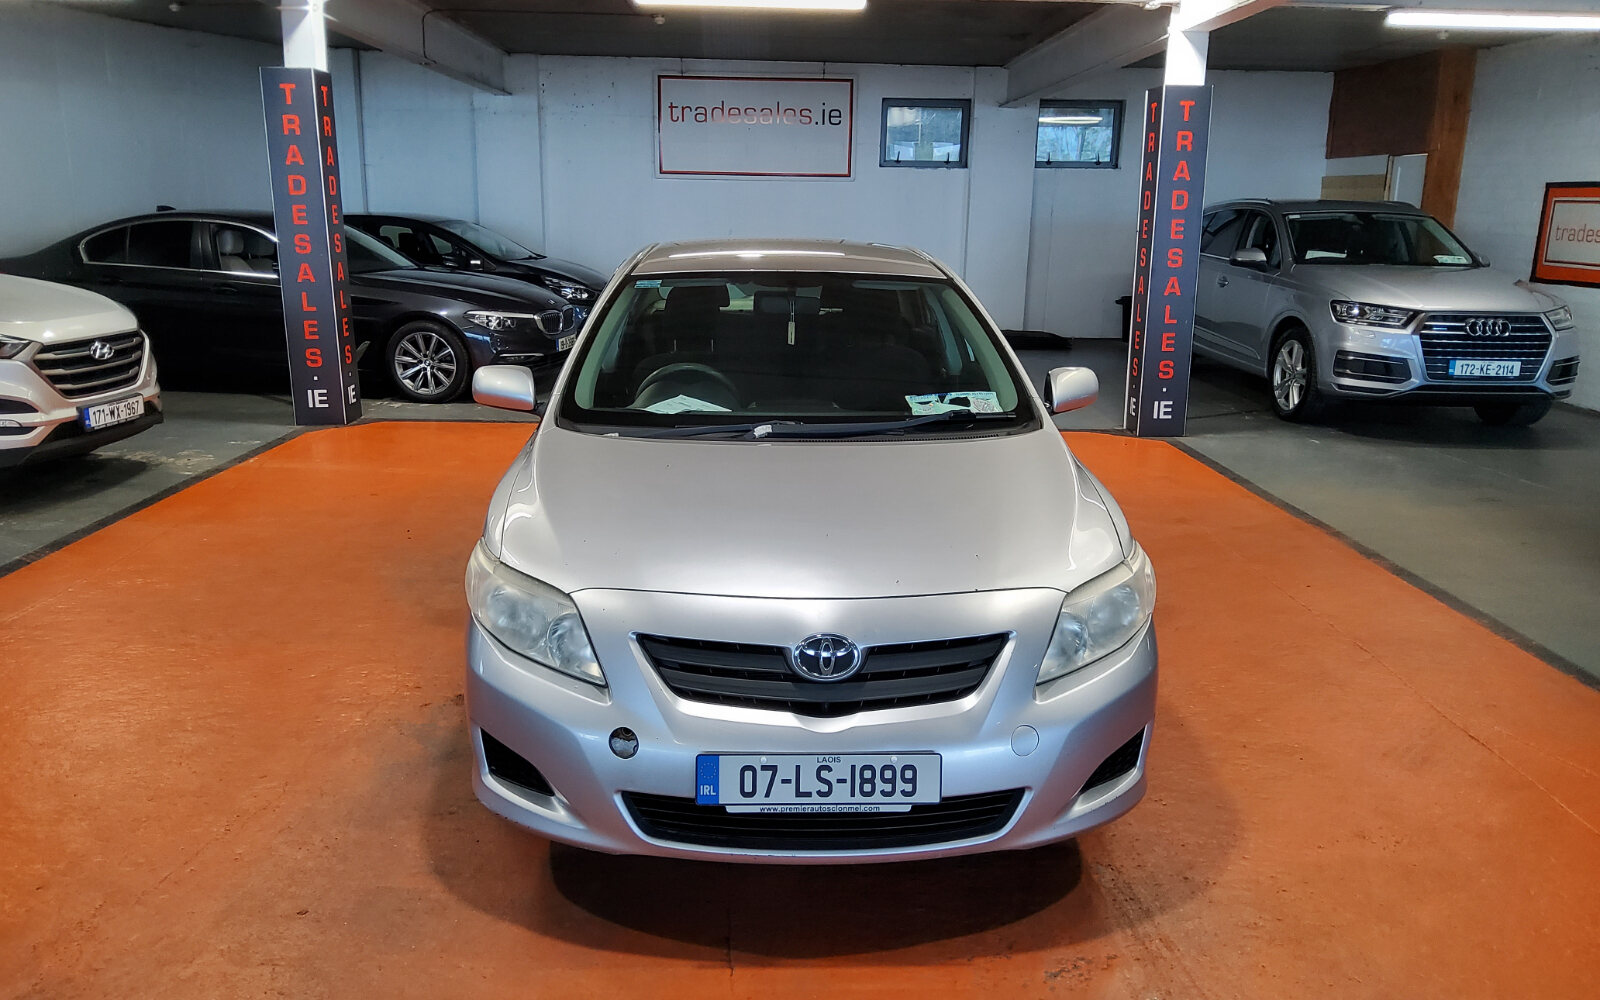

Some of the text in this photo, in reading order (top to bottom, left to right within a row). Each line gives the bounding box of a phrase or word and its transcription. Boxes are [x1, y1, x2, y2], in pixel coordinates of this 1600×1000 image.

[668, 100, 842, 126] tradesales.ie
[1460, 363, 1515, 375] 172-KE-2114
[93, 400, 140, 425] 171-WX-1967
[816, 756, 841, 764] LAOIS
[739, 764, 918, 798] 07-LS-1899
[700, 785, 716, 796] IRL
